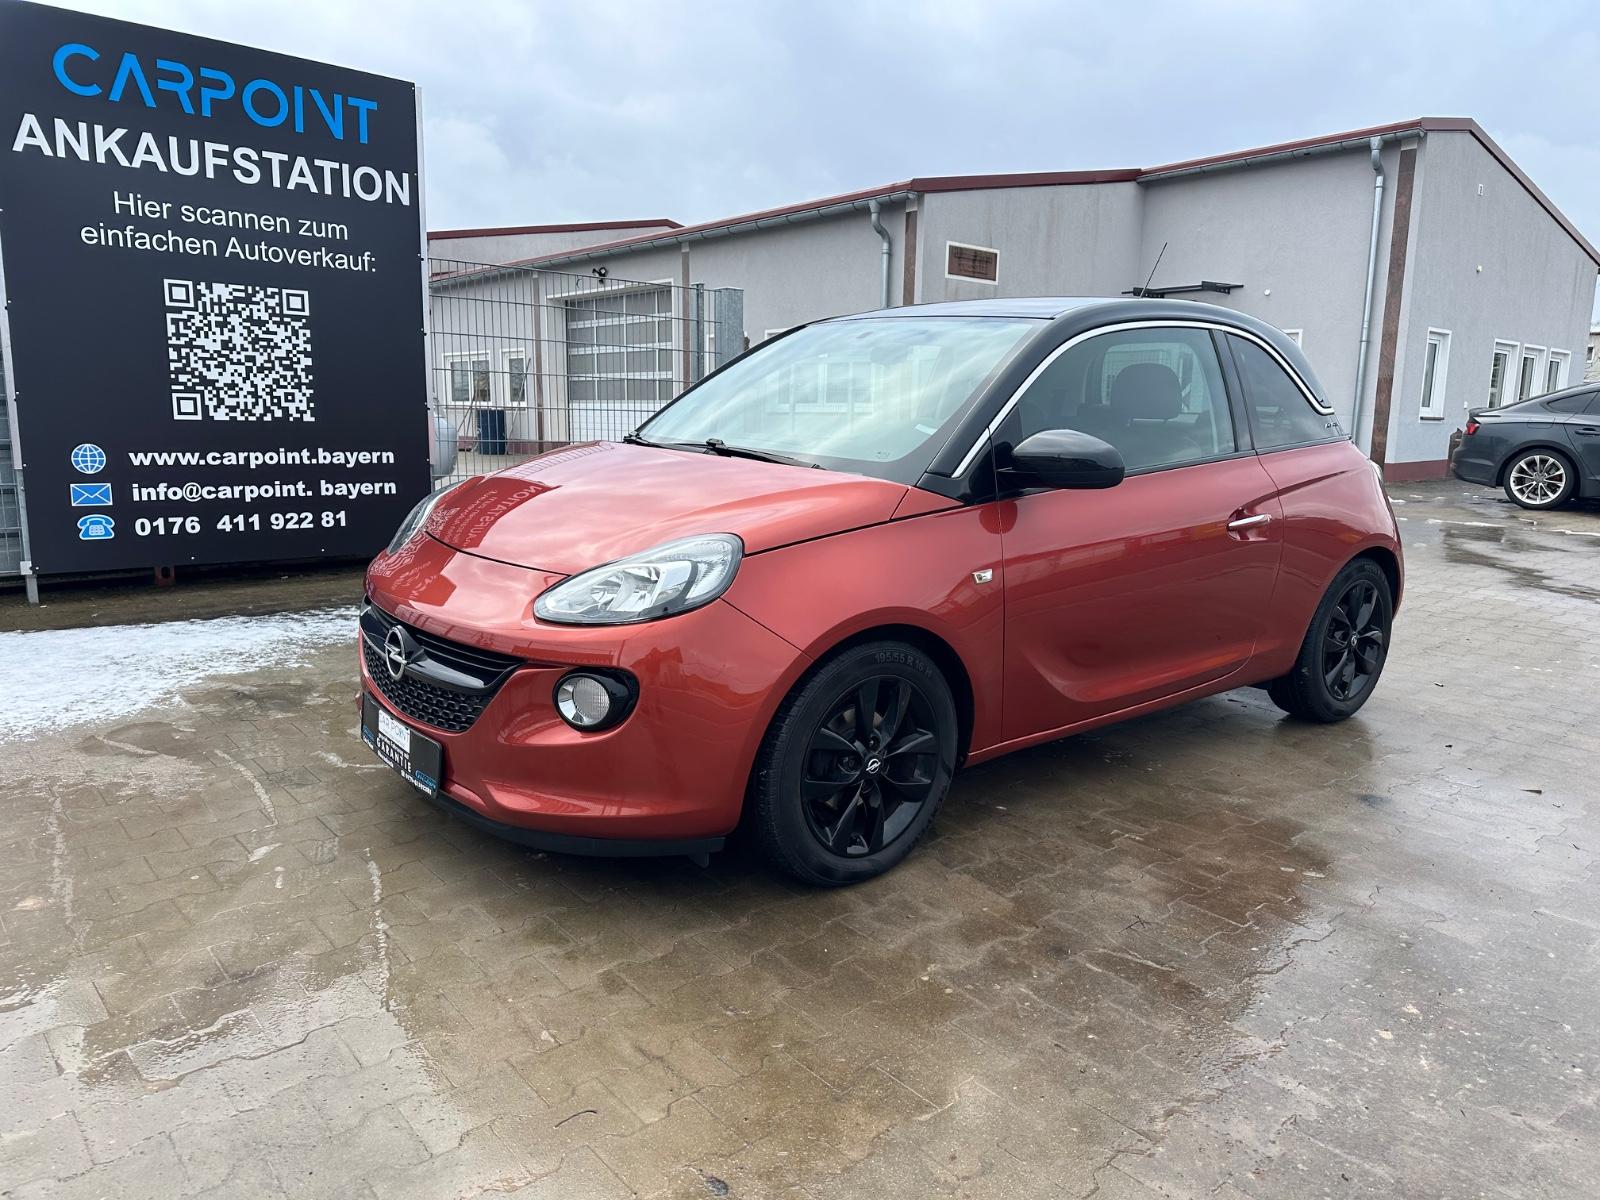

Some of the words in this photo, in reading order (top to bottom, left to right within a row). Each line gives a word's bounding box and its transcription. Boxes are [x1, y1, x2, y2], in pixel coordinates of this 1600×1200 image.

[53, 43, 377, 144] CARPOINT
[12, 113, 410, 206] ANKAUFSTATION
[114, 191, 172, 219] Hier
[181, 203, 290, 233] scannen
[299, 219, 349, 240] zum
[81, 223, 217, 256] einfachen
[225, 237, 376, 272] Autoverkauf:
[128, 448, 395, 468] www.carpoint.bayern
[132, 481, 313, 502] info@carpoint.
[320, 480, 397, 499] bayern
[135, 517, 201, 536] 0176
[217, 513, 260, 531] 411
[271, 512, 314, 530] 922
[321, 511, 346, 528] 81
[376, 736, 412, 773] GARANTIE
